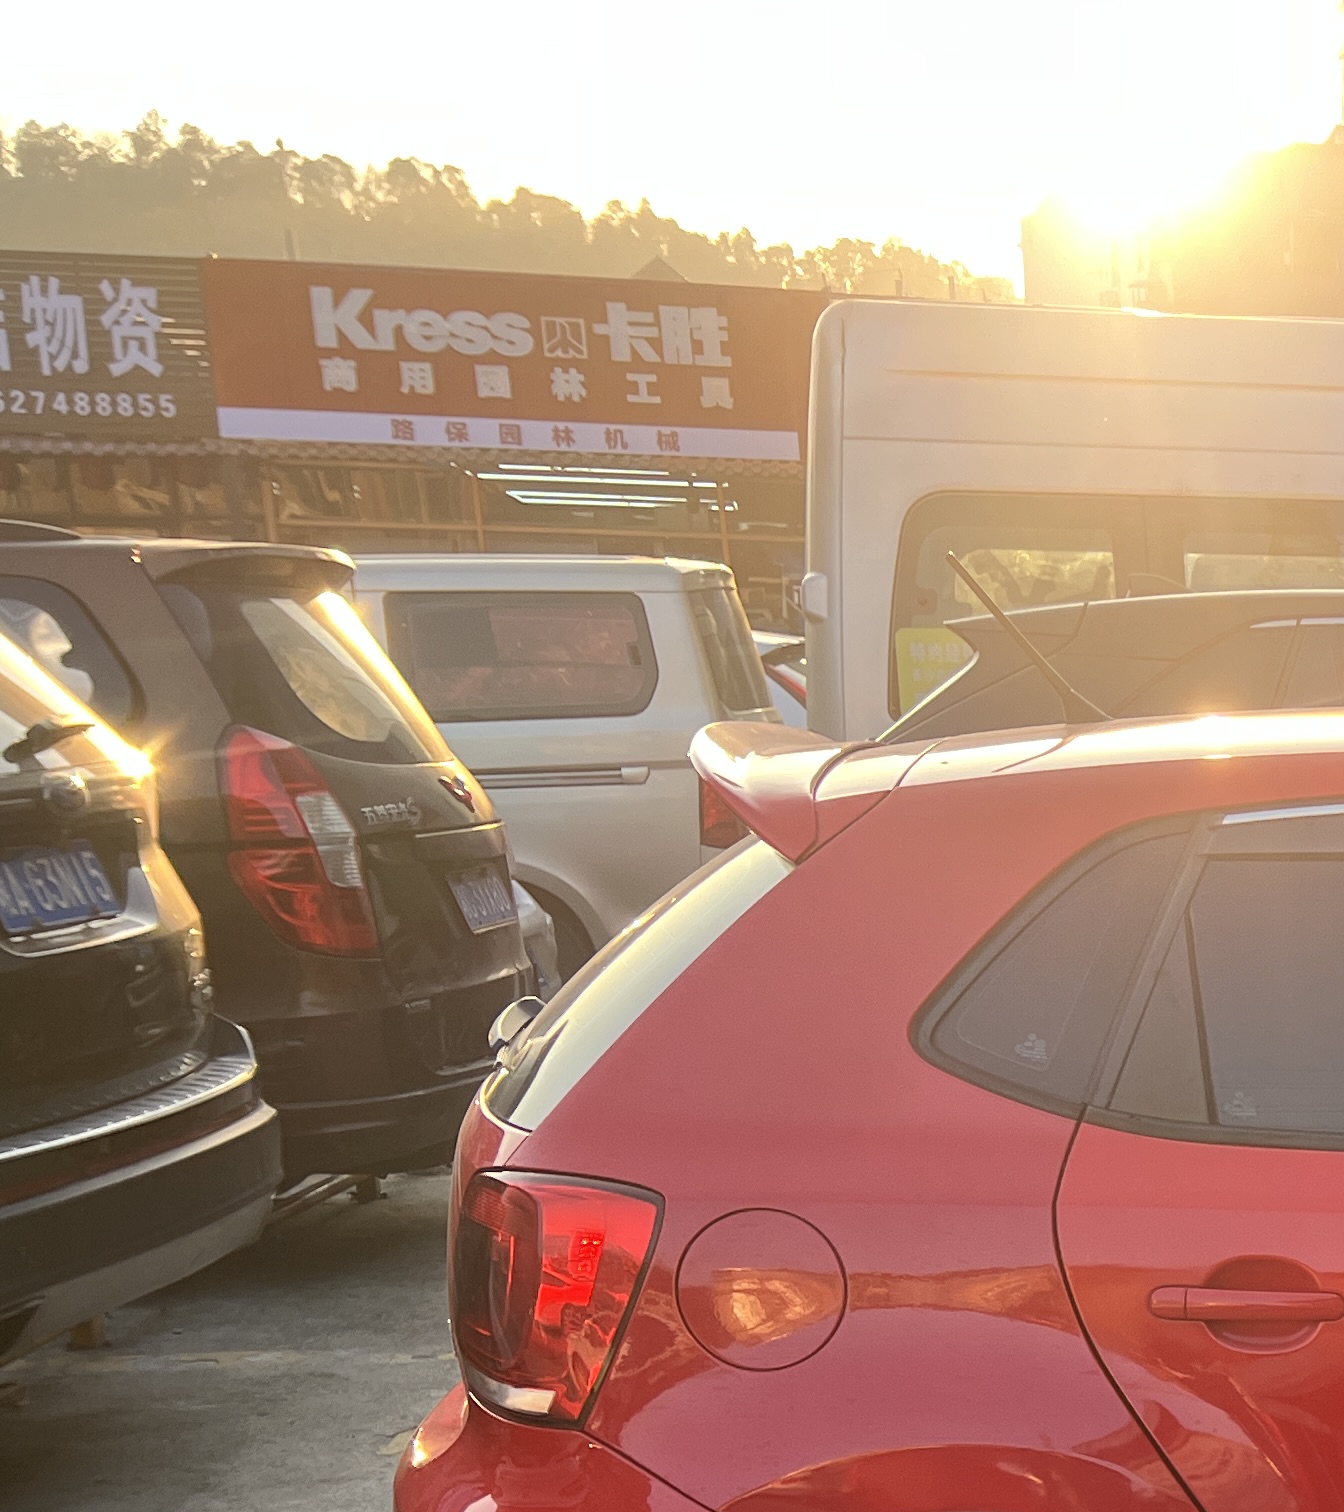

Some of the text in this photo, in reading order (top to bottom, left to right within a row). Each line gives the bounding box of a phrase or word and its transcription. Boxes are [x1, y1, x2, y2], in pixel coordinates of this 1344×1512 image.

[0, 275, 165, 378] 物资
[309, 285, 733, 367] Kress 卡胜
[318, 356, 735, 410] 商用园林工具
